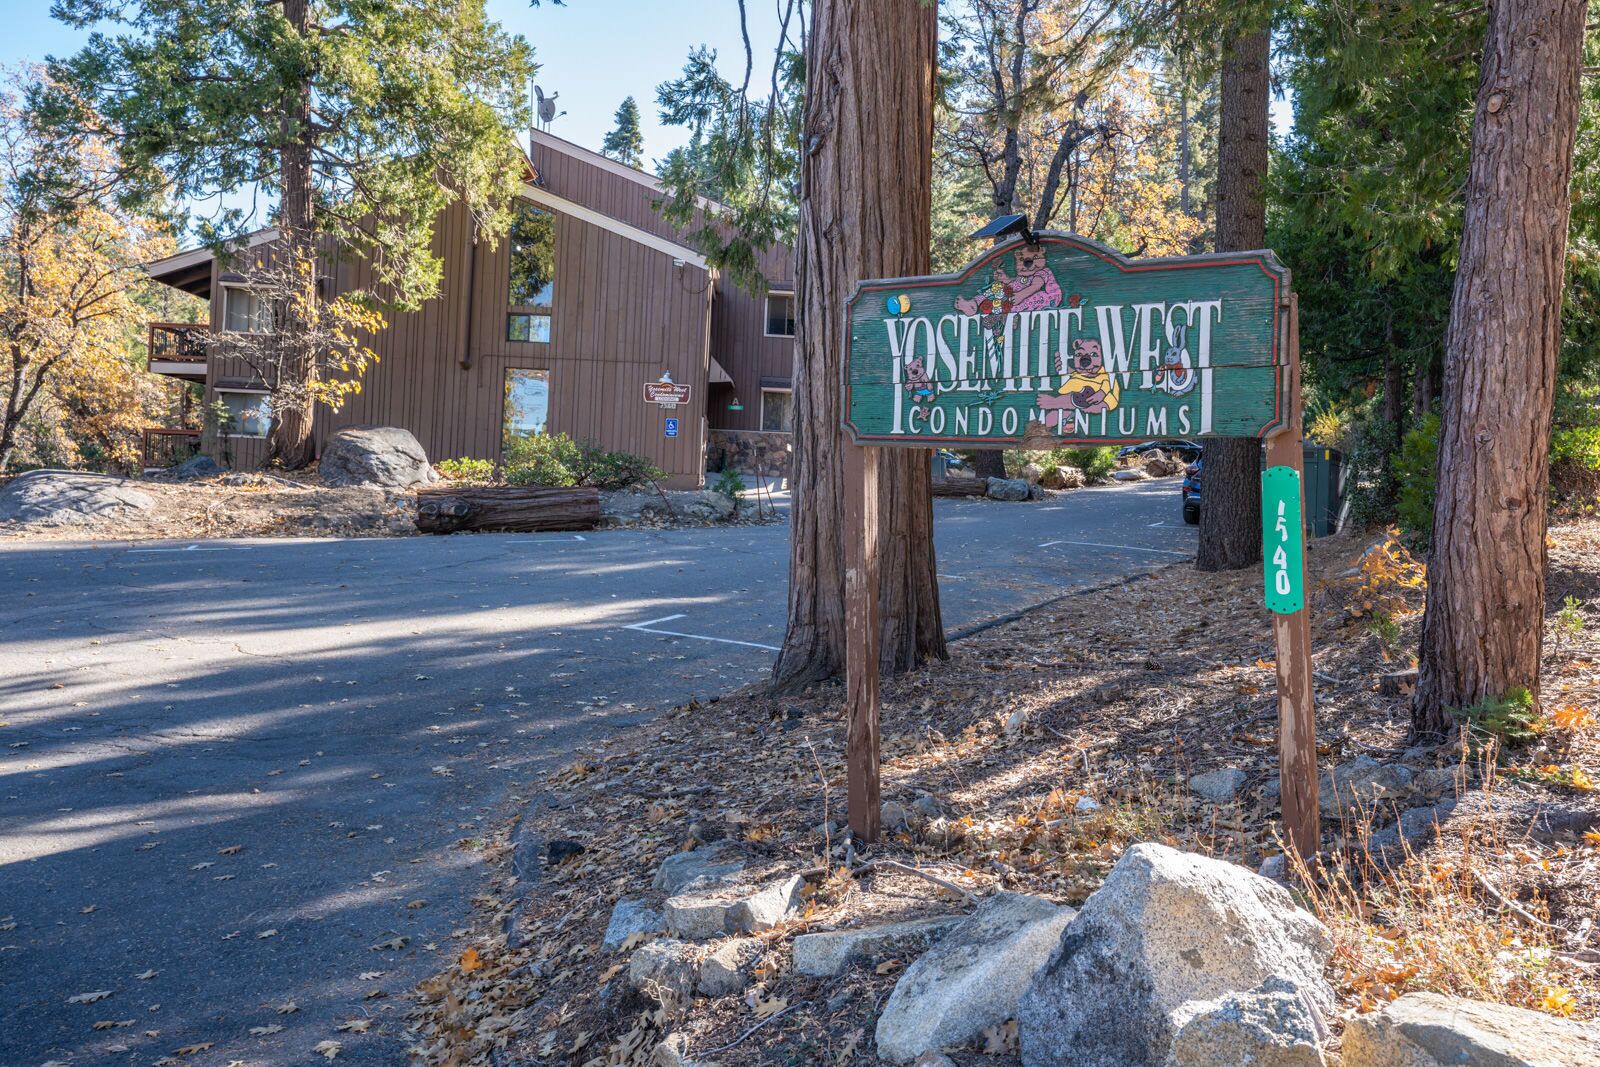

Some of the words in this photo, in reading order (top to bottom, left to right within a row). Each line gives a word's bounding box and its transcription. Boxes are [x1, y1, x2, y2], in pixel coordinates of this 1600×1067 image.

[884, 306, 1082, 434] YOSEMITE
[1095, 299, 1222, 436] WEST
[1273, 500, 1290, 595] 1540
